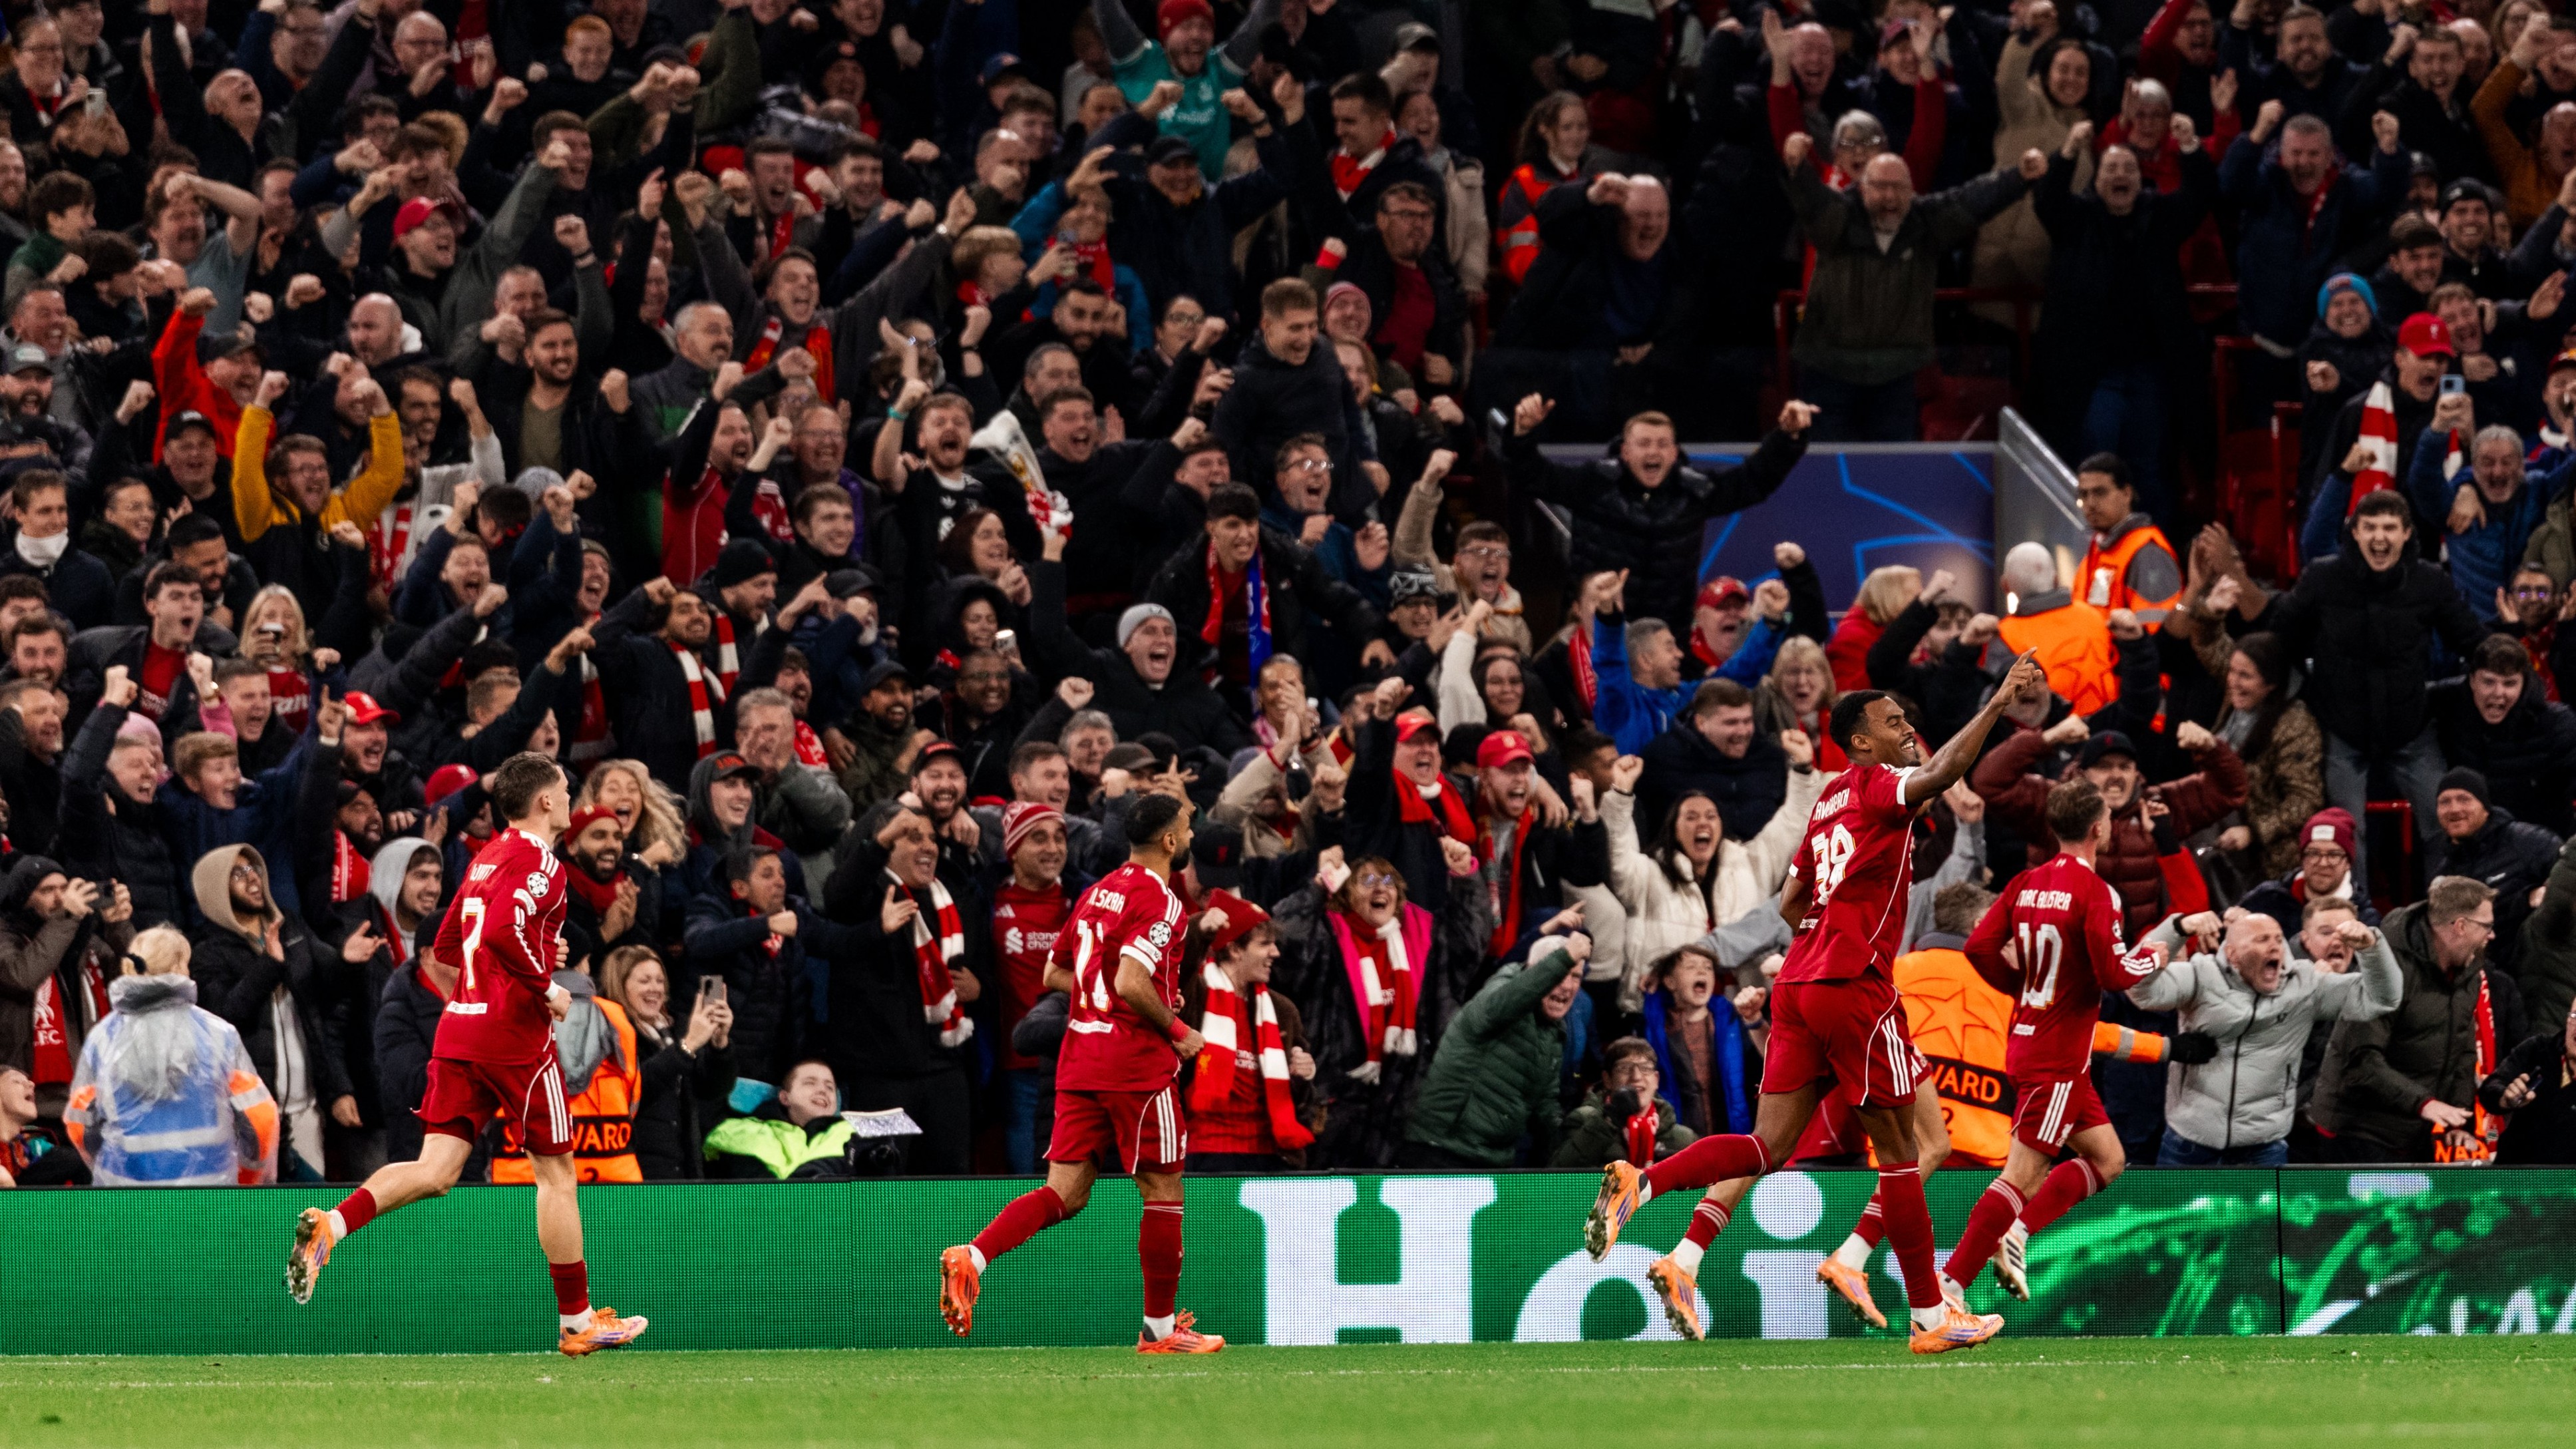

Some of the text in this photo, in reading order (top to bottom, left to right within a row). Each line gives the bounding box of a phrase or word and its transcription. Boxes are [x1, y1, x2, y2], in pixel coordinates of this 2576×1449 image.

[462, 897, 485, 989] 7
[2018, 923, 2063, 1010] 10
[35, 1030, 63, 1047] FC
